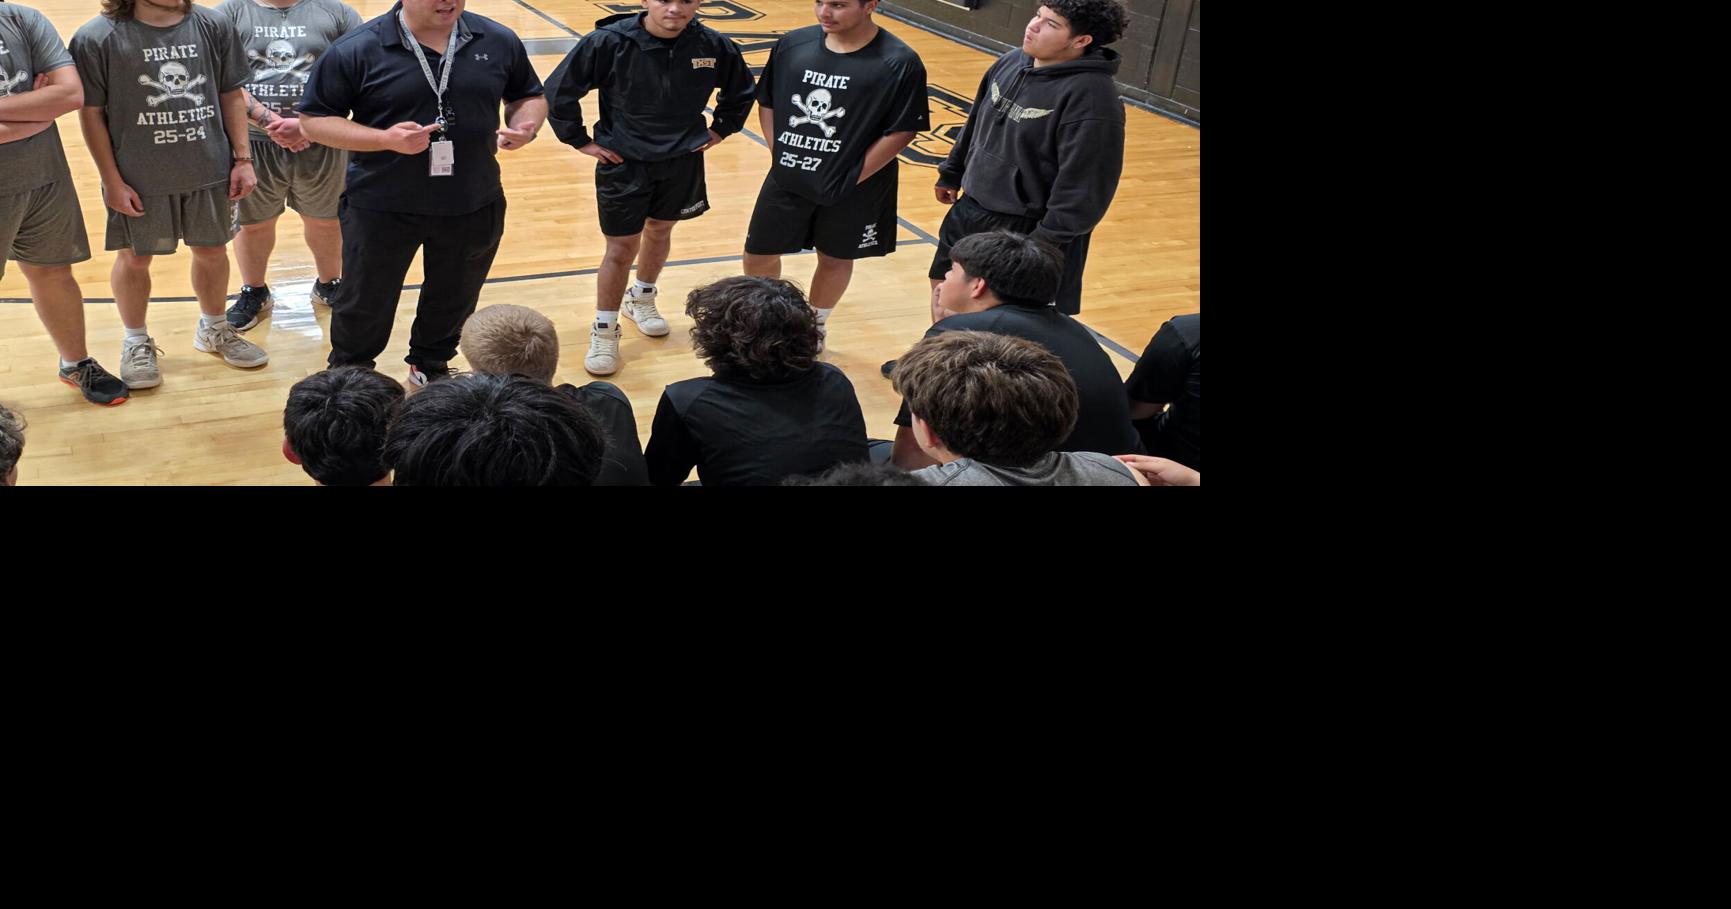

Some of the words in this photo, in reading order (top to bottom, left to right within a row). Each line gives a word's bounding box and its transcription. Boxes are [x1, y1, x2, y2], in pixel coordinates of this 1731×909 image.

[253, 25, 307, 38] PIRATE
[142, 44, 199, 62] PIRATE
[802, 69, 850, 90] PIRATE
[136, 105, 215, 125] ATHLETICS
[153, 125, 207, 144] 25-24
[778, 131, 842, 153] ATHLETICS
[779, 151, 823, 172] 25-27
